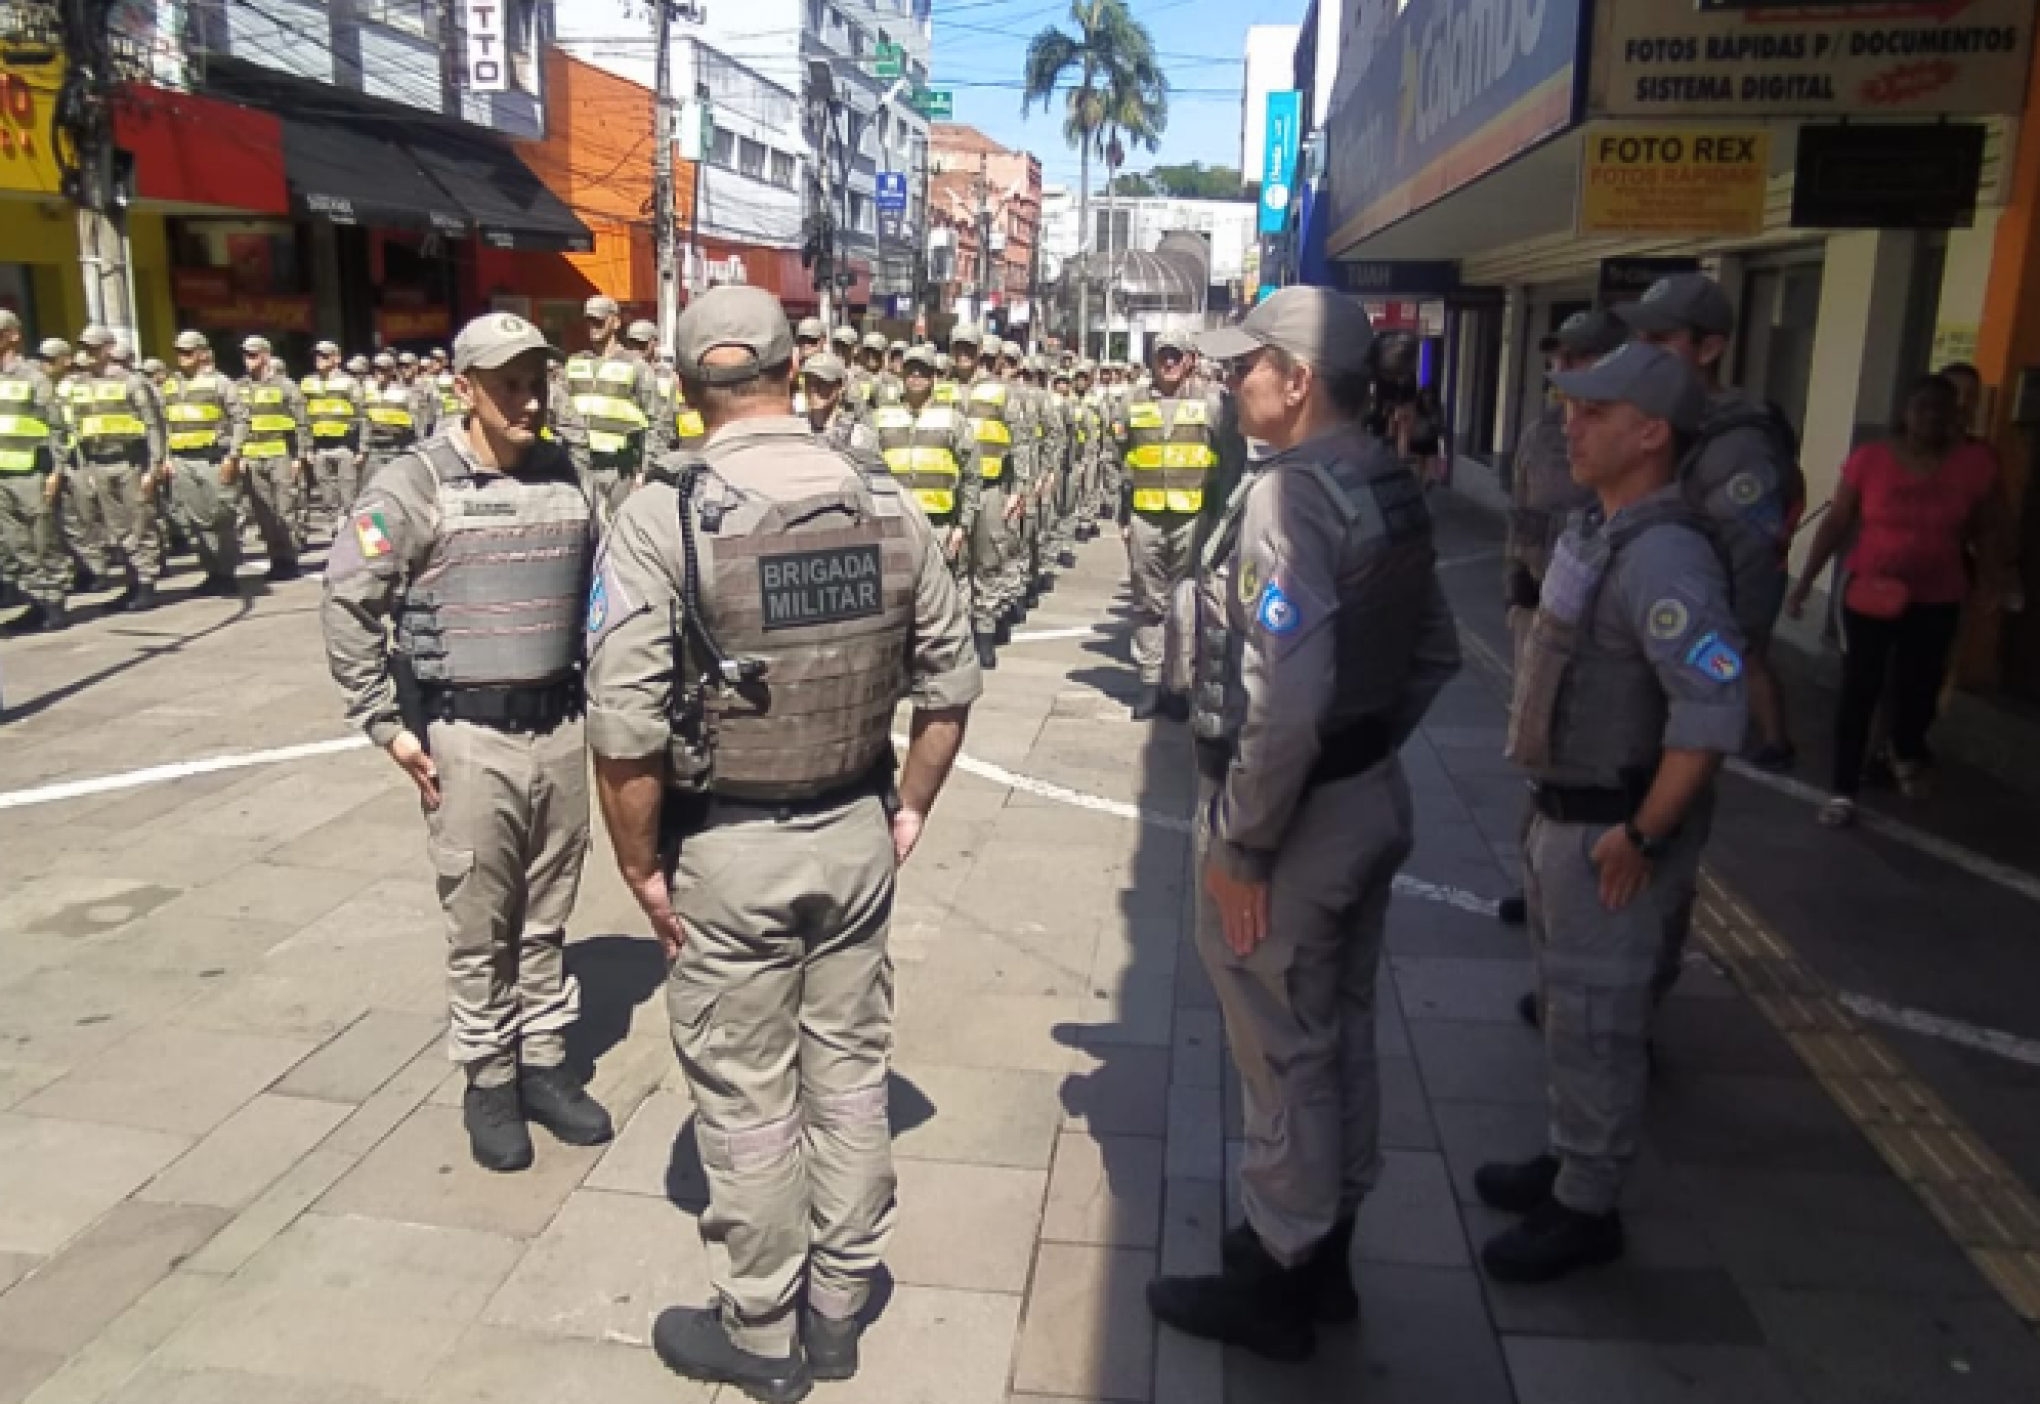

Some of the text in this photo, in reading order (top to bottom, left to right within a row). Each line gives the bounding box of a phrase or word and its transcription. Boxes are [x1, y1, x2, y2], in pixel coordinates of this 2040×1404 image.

[1625, 38, 1697, 62] FOTOS
[1705, 30, 1806, 60] RÁPIDAS
[1849, 27, 2018, 56] DOCUMENTOS
[1637, 74, 1834, 101] SISTEMA DIGITAL
[1600, 136, 1757, 163] FOTO REX
[1590, 167, 1657, 186] FOTOS
[764, 552, 877, 588] BRIGADA
[768, 583, 876, 620] MILITAR
